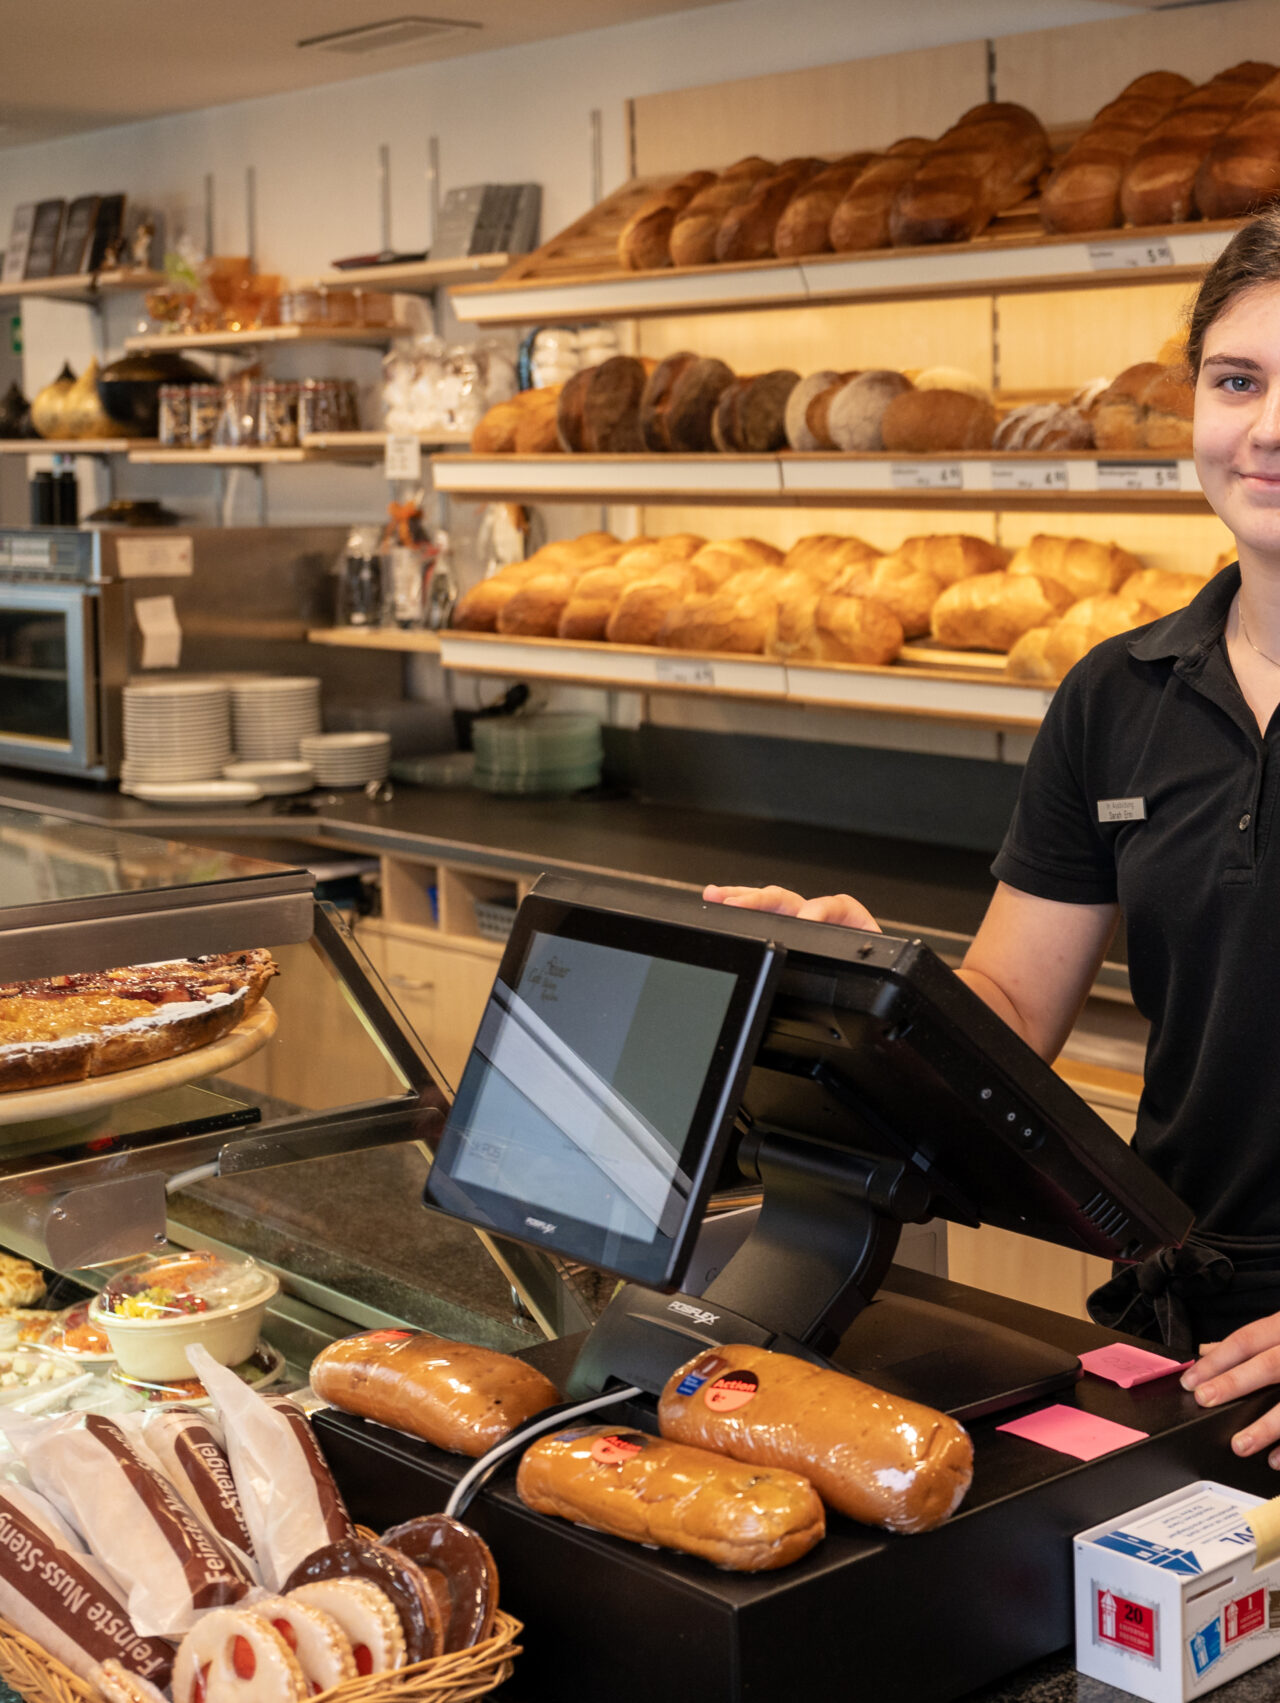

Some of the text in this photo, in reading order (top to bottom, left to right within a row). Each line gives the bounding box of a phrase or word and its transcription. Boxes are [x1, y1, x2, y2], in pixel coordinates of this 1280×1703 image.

[667, 1301, 720, 1326] POSIFLEX
[714, 1379, 757, 1392] Action
[182, 1516, 227, 1585] Feinste
[1124, 1604, 1143, 1625] 20
[87, 1602, 165, 1677] Feinste
